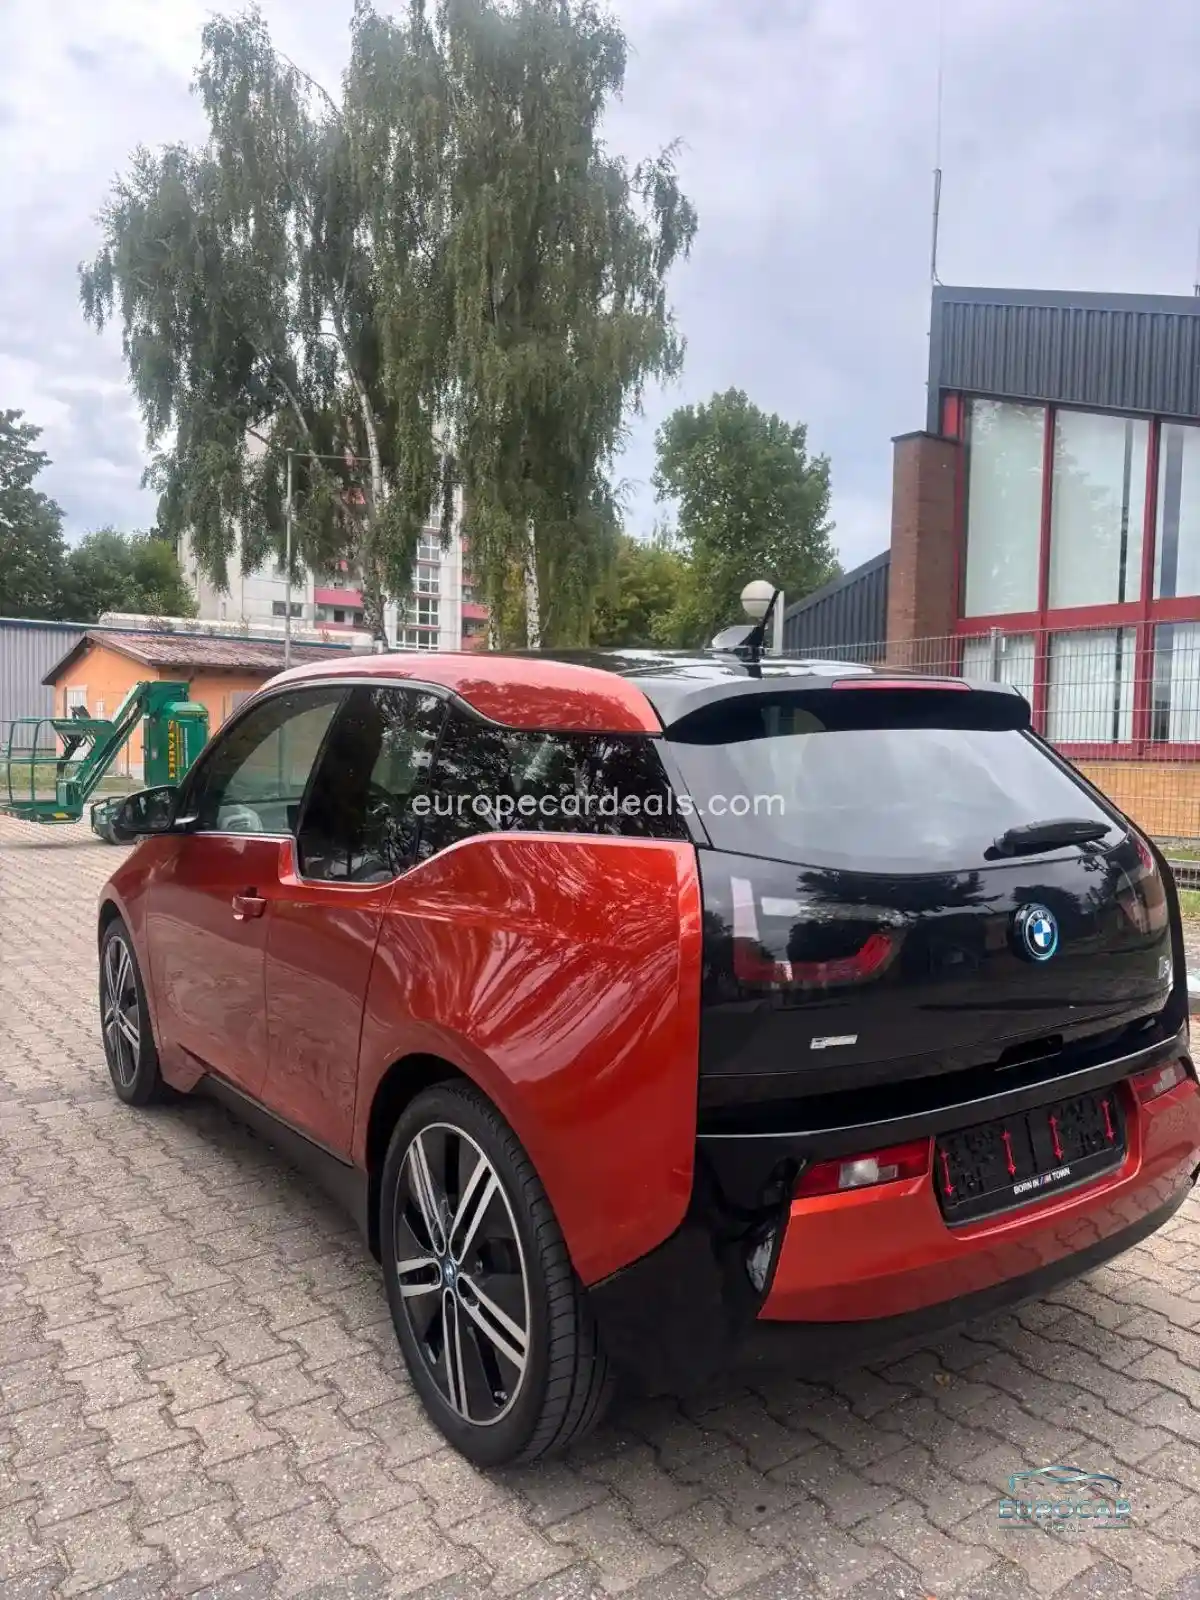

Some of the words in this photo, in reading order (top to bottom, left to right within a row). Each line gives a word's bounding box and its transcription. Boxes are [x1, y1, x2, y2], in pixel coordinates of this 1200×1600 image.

[1013, 1179, 1033, 1195] BORN
[1032, 1178, 1040, 1189] IN
[1052, 1167, 1071, 1181] TOWN
